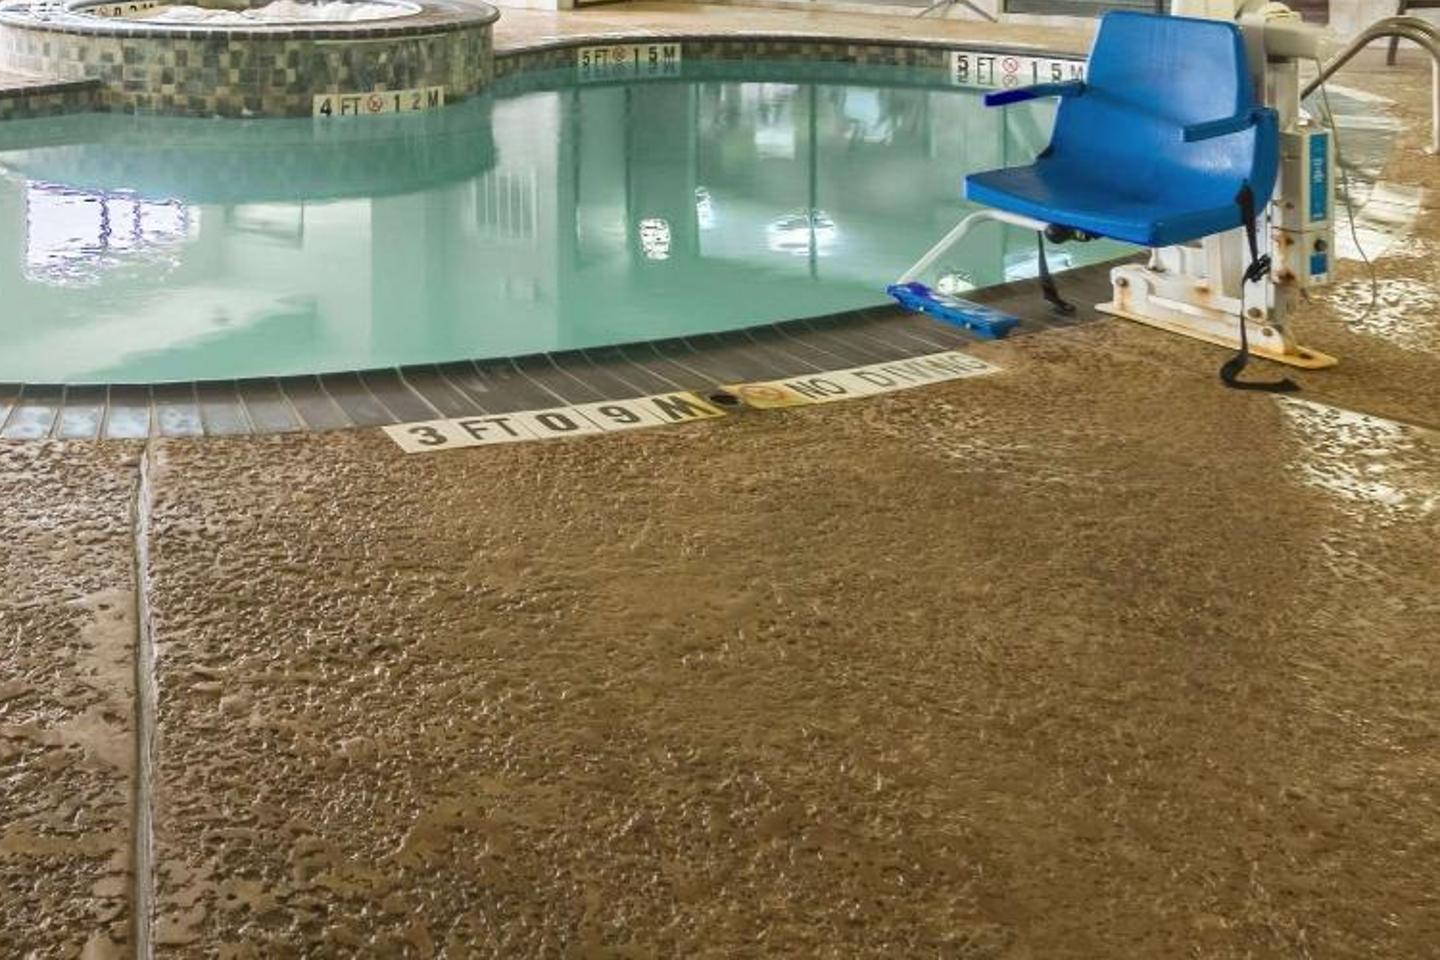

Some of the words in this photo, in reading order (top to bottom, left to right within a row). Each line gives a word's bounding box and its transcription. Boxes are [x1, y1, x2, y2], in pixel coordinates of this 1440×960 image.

[458, 416, 520, 441] FT
[784, 376, 848, 401] NO
[850, 354, 990, 388] DIVING
